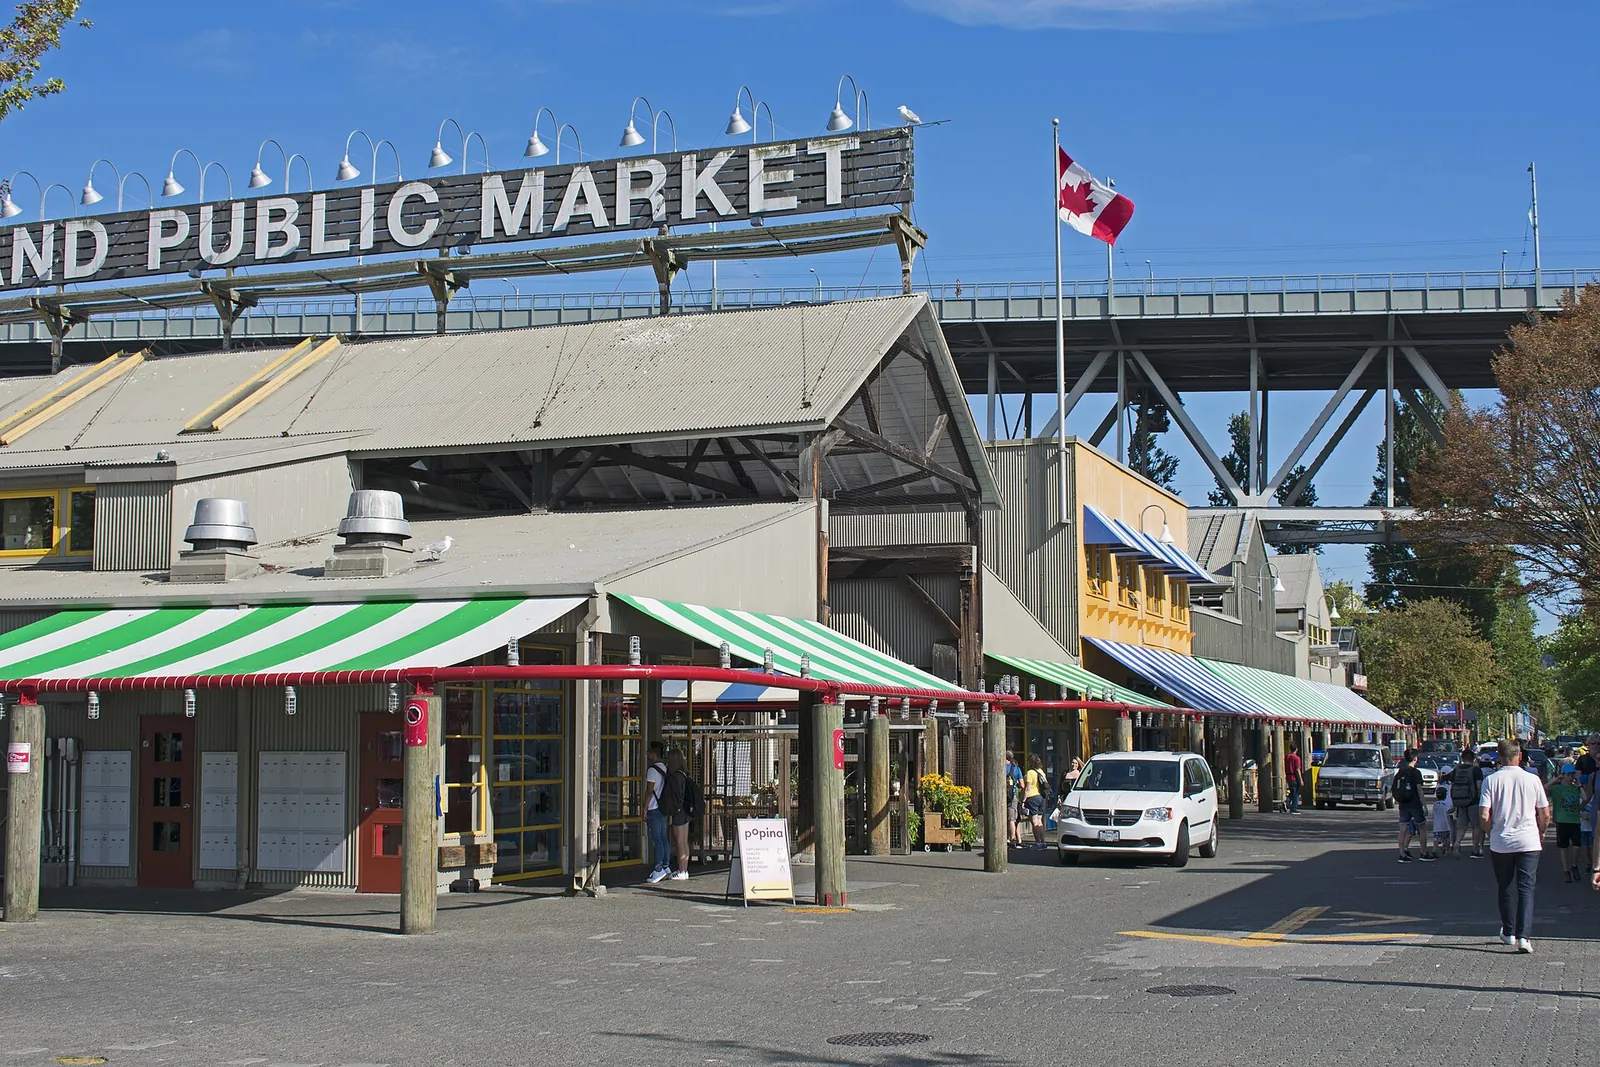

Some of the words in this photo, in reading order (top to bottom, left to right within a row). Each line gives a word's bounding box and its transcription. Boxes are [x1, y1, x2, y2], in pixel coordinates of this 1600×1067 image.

[0, 220, 108, 285] ND
[147, 181, 440, 270] PUBLIC
[480, 137, 860, 239] MARKET
[745, 828, 783, 840] popina
